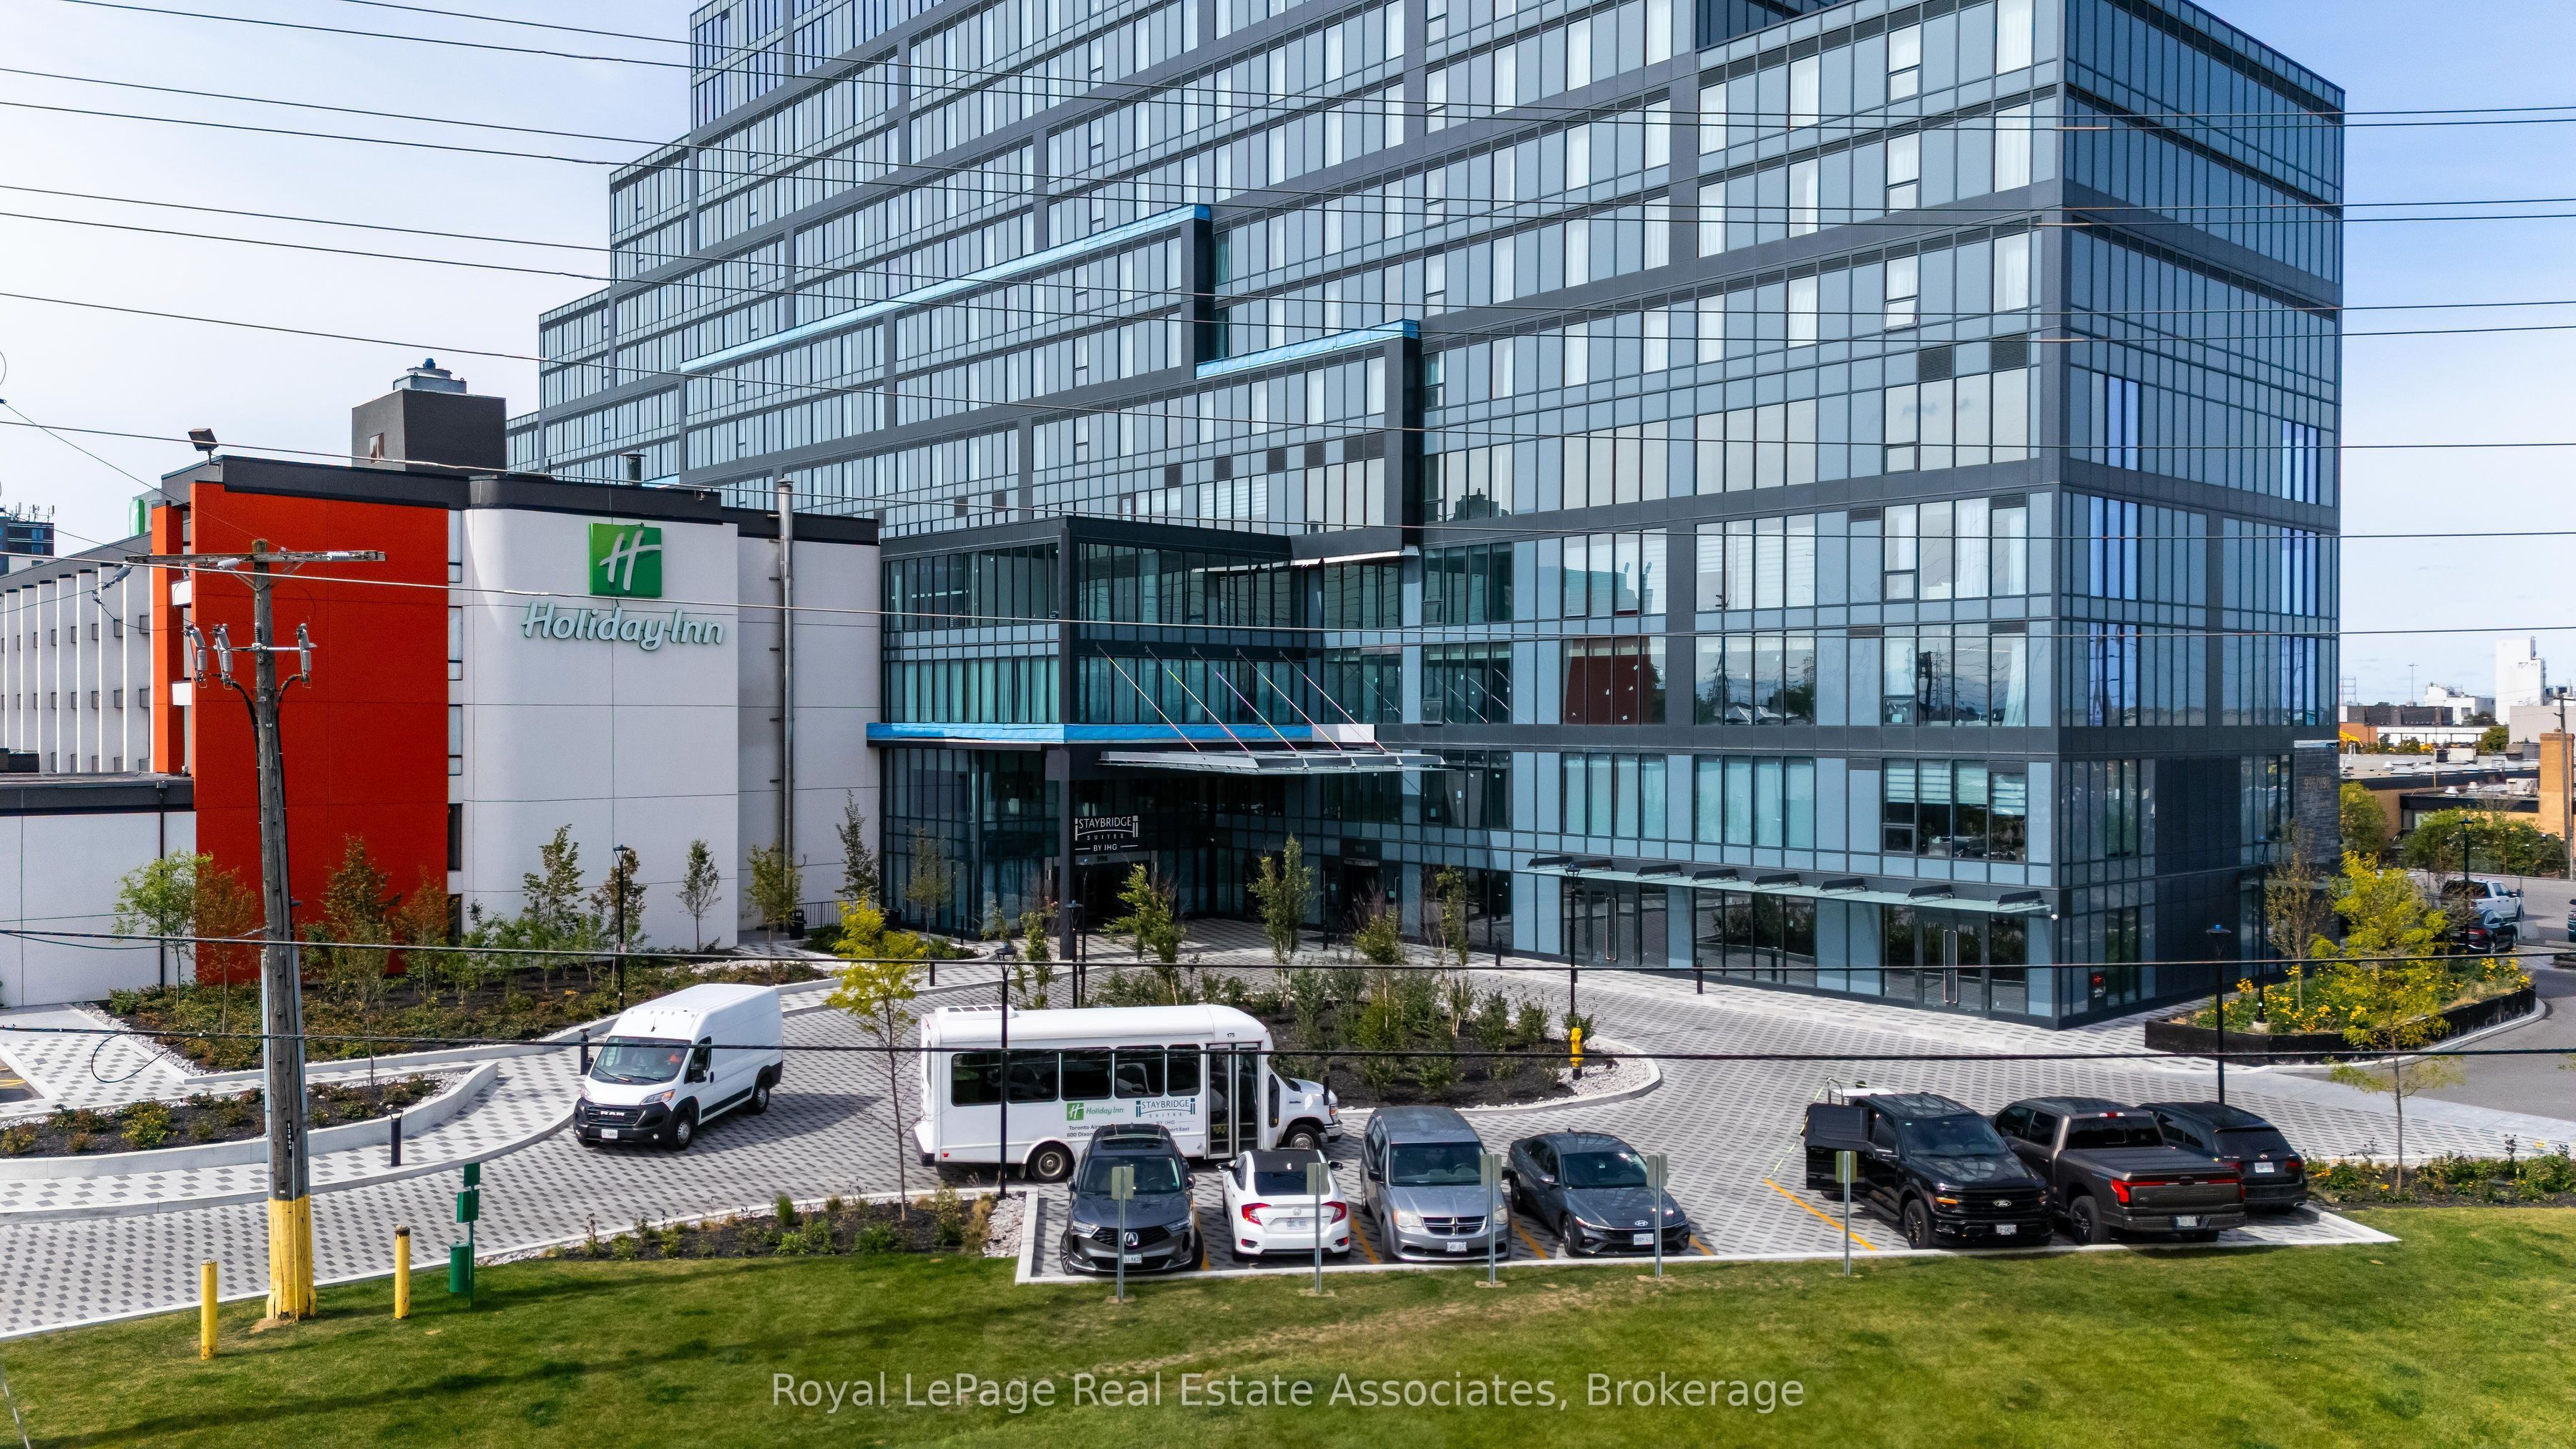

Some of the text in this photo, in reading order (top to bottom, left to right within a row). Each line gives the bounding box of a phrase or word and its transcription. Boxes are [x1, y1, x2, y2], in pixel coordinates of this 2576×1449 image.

[522, 602, 723, 650] Holiday Inn
[1078, 816, 1131, 829] STAYBRIDGE
[1141, 1099, 1189, 1109] STAYBRIDGE
[1086, 1107, 1112, 1116] Holiday
